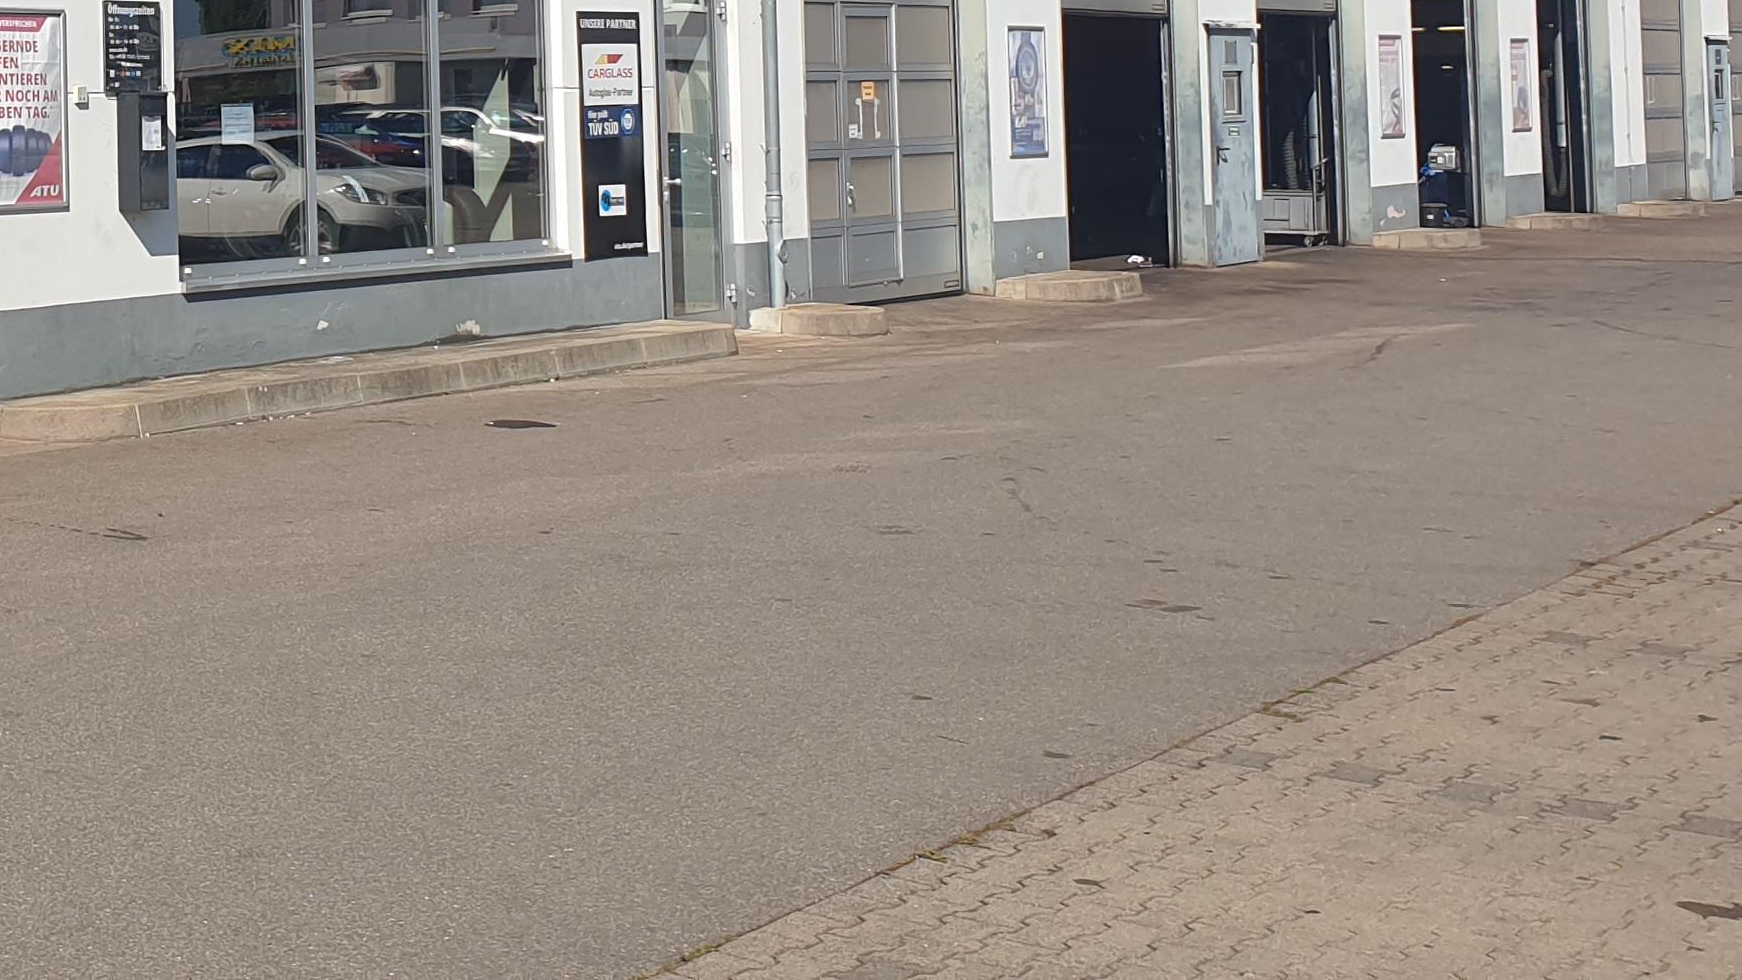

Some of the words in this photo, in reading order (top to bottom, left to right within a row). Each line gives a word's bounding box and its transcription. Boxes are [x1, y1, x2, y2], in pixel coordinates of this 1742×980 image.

[587, 67, 633, 79] CARGLASS
[5, 89, 40, 103] NOCH
[43, 89, 59, 103] AM
[588, 119, 603, 136] TÜV
[603, 118, 619, 135] SÜD
[30, 184, 60, 198] ATU
